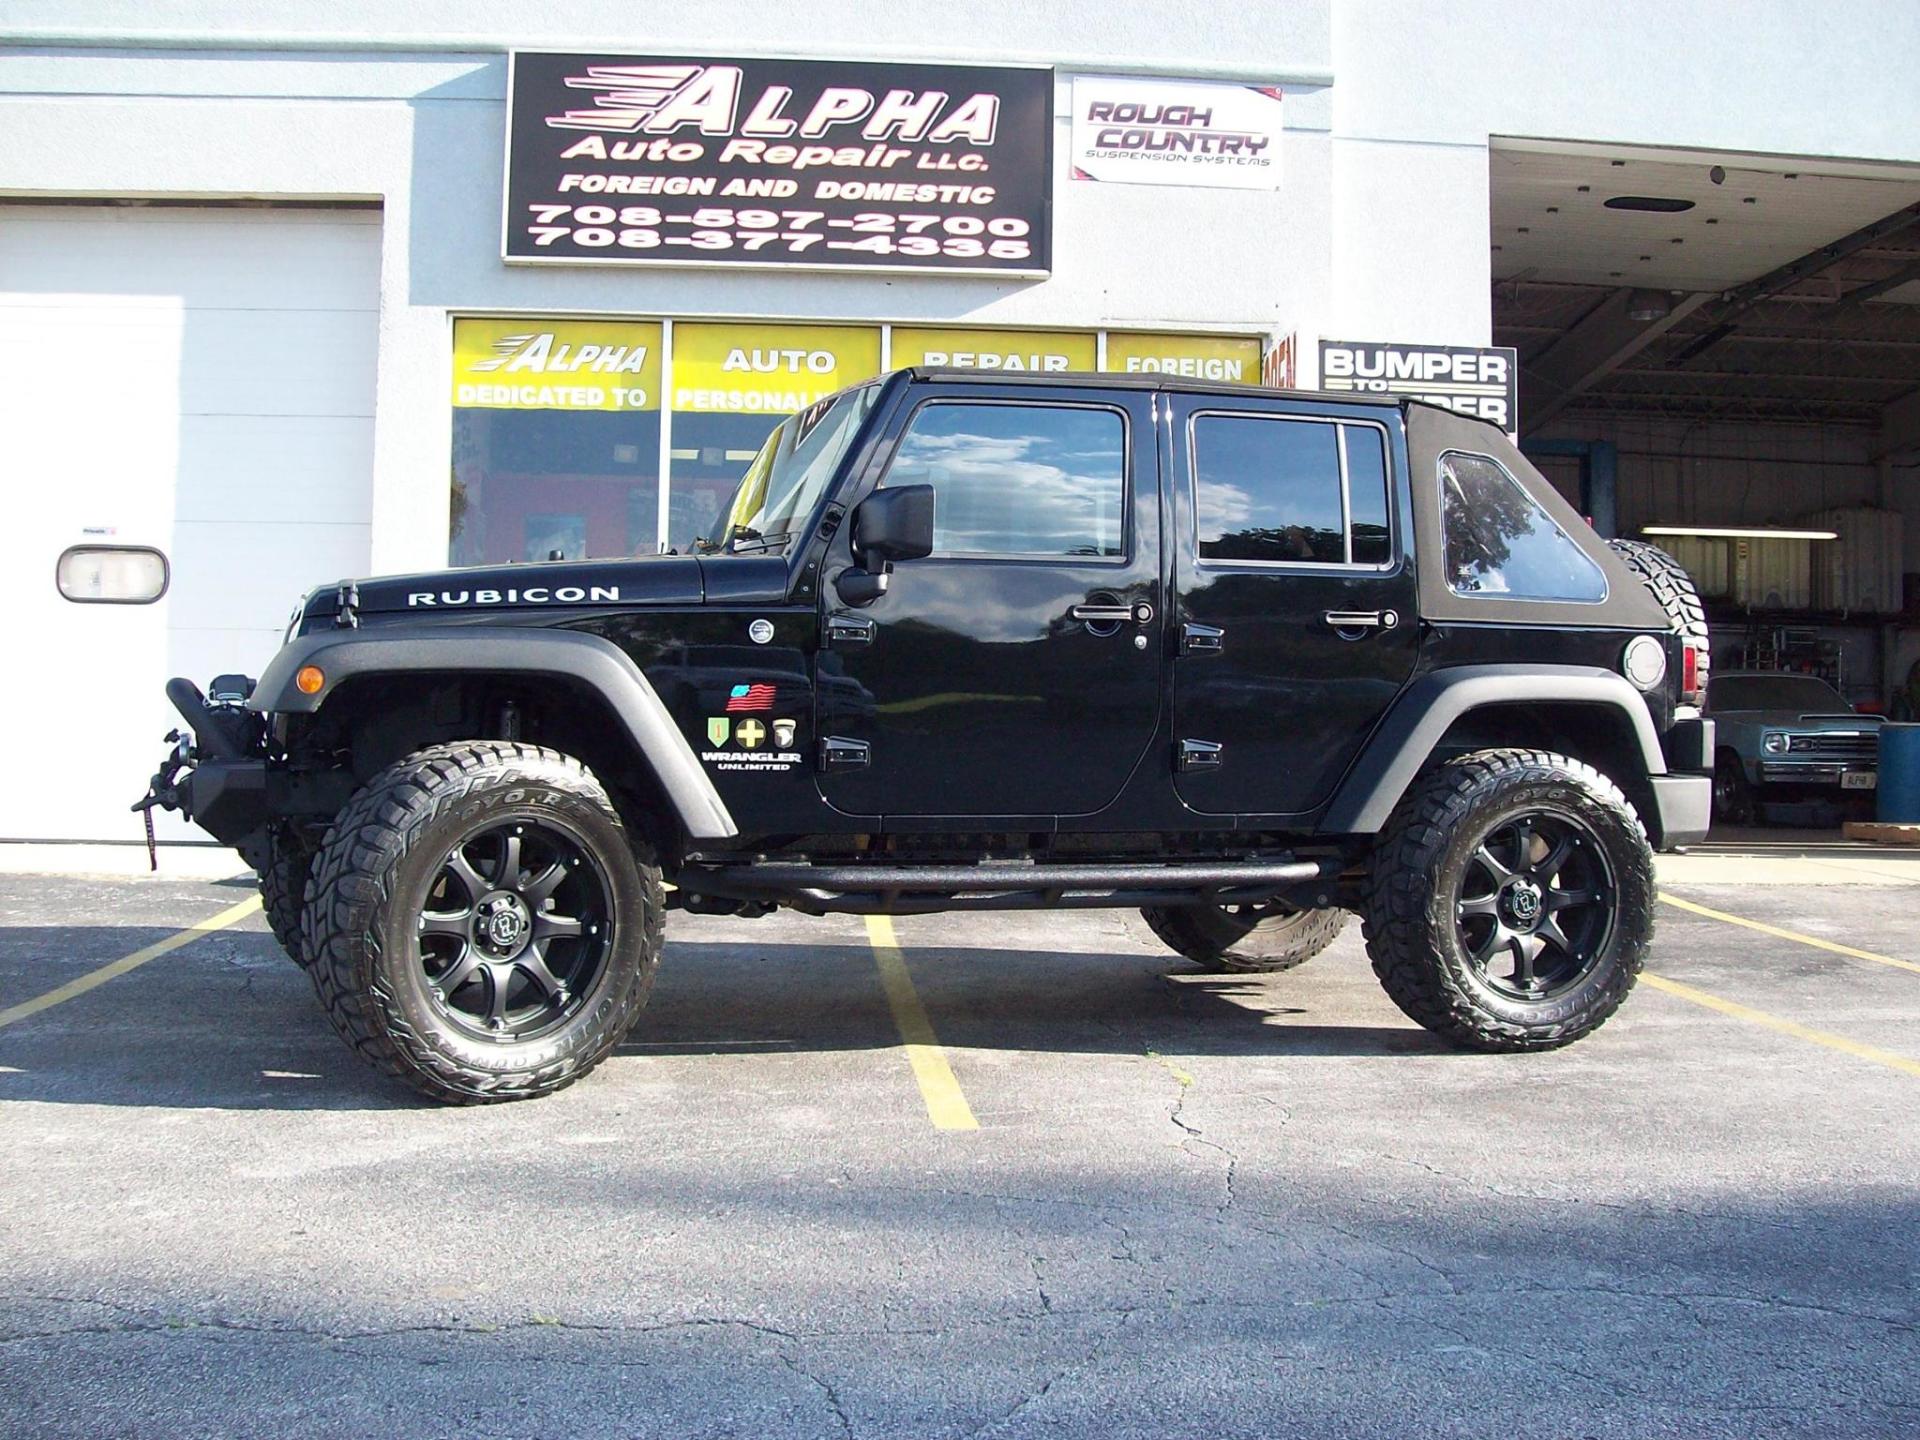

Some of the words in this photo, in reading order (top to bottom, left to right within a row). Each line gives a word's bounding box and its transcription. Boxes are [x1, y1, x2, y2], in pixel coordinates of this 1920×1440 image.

[643, 63, 1000, 146] ALPHA
[1087, 101, 1213, 127] ROUGH
[560, 136, 705, 162] Auto
[718, 139, 912, 170] Repair
[1095, 128, 1270, 156] COUNTRY
[1085, 149, 1188, 163] SUSPENSION
[1191, 155, 1272, 167] SYSTEMS
[557, 173, 720, 197] FOREIGN
[719, 178, 798, 198] AND
[814, 181, 996, 205] DOMESTIC
[527, 204, 1031, 238] 708-597-2700
[506, 333, 649, 374] ALPHA
[722, 349, 838, 374] AUTO
[1126, 357, 1242, 381] FOREIGN
[1324, 348, 1508, 383] BUMPER
[457, 384, 610, 407] DEDICATED
[612, 388, 648, 408] TO
[1351, 378, 1390, 392] TO
[408, 586, 619, 607] RUBICON
[701, 751, 803, 763] WRANGLER
[717, 763, 791, 771] UNLIMITED
